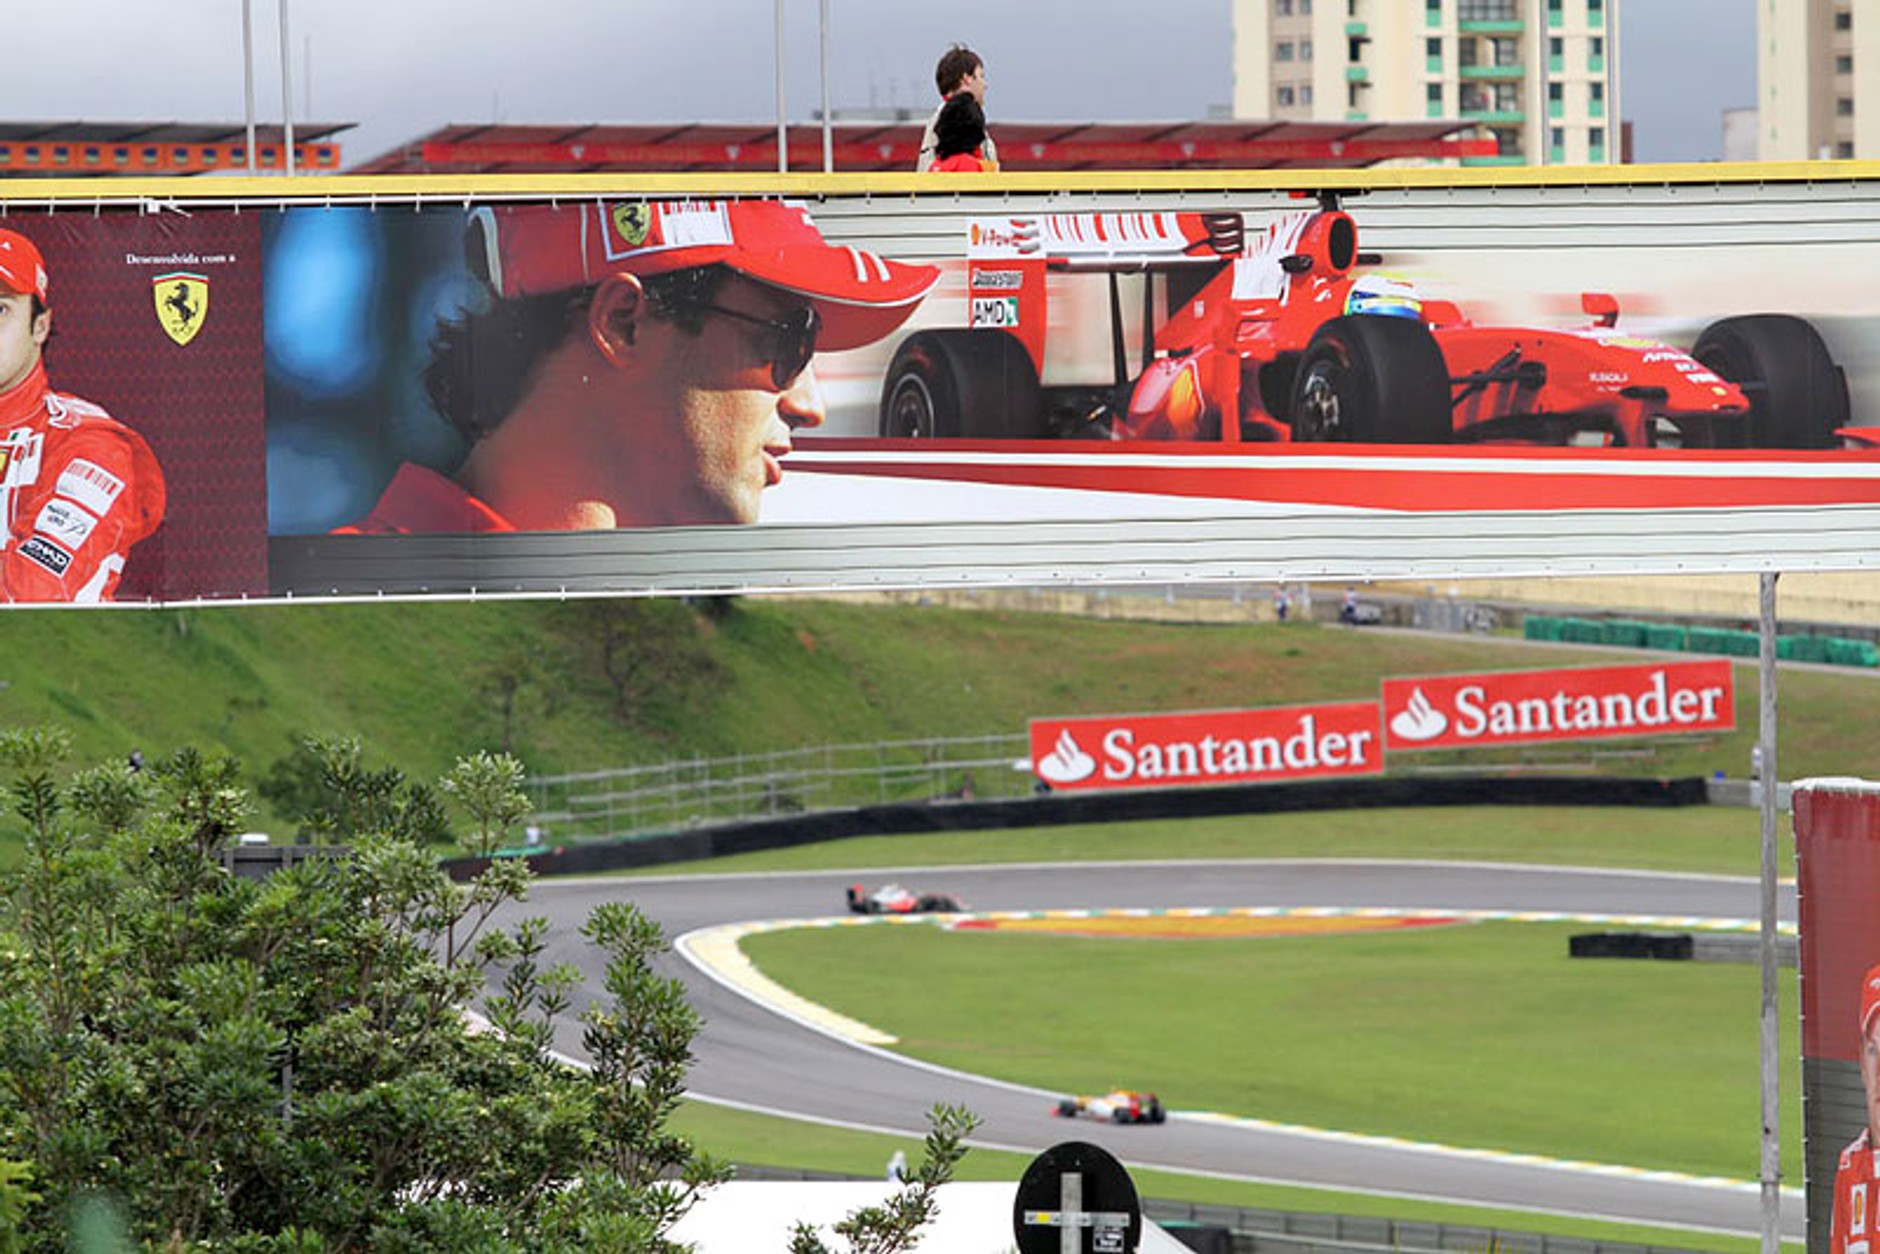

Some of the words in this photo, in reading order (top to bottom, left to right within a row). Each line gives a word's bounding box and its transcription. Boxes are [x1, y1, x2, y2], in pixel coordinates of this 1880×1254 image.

[202, 255, 226, 264] com
[974, 300, 1005, 324] AMD
[1454, 670, 1723, 736] Santander
[1102, 714, 1372, 780] Santander
